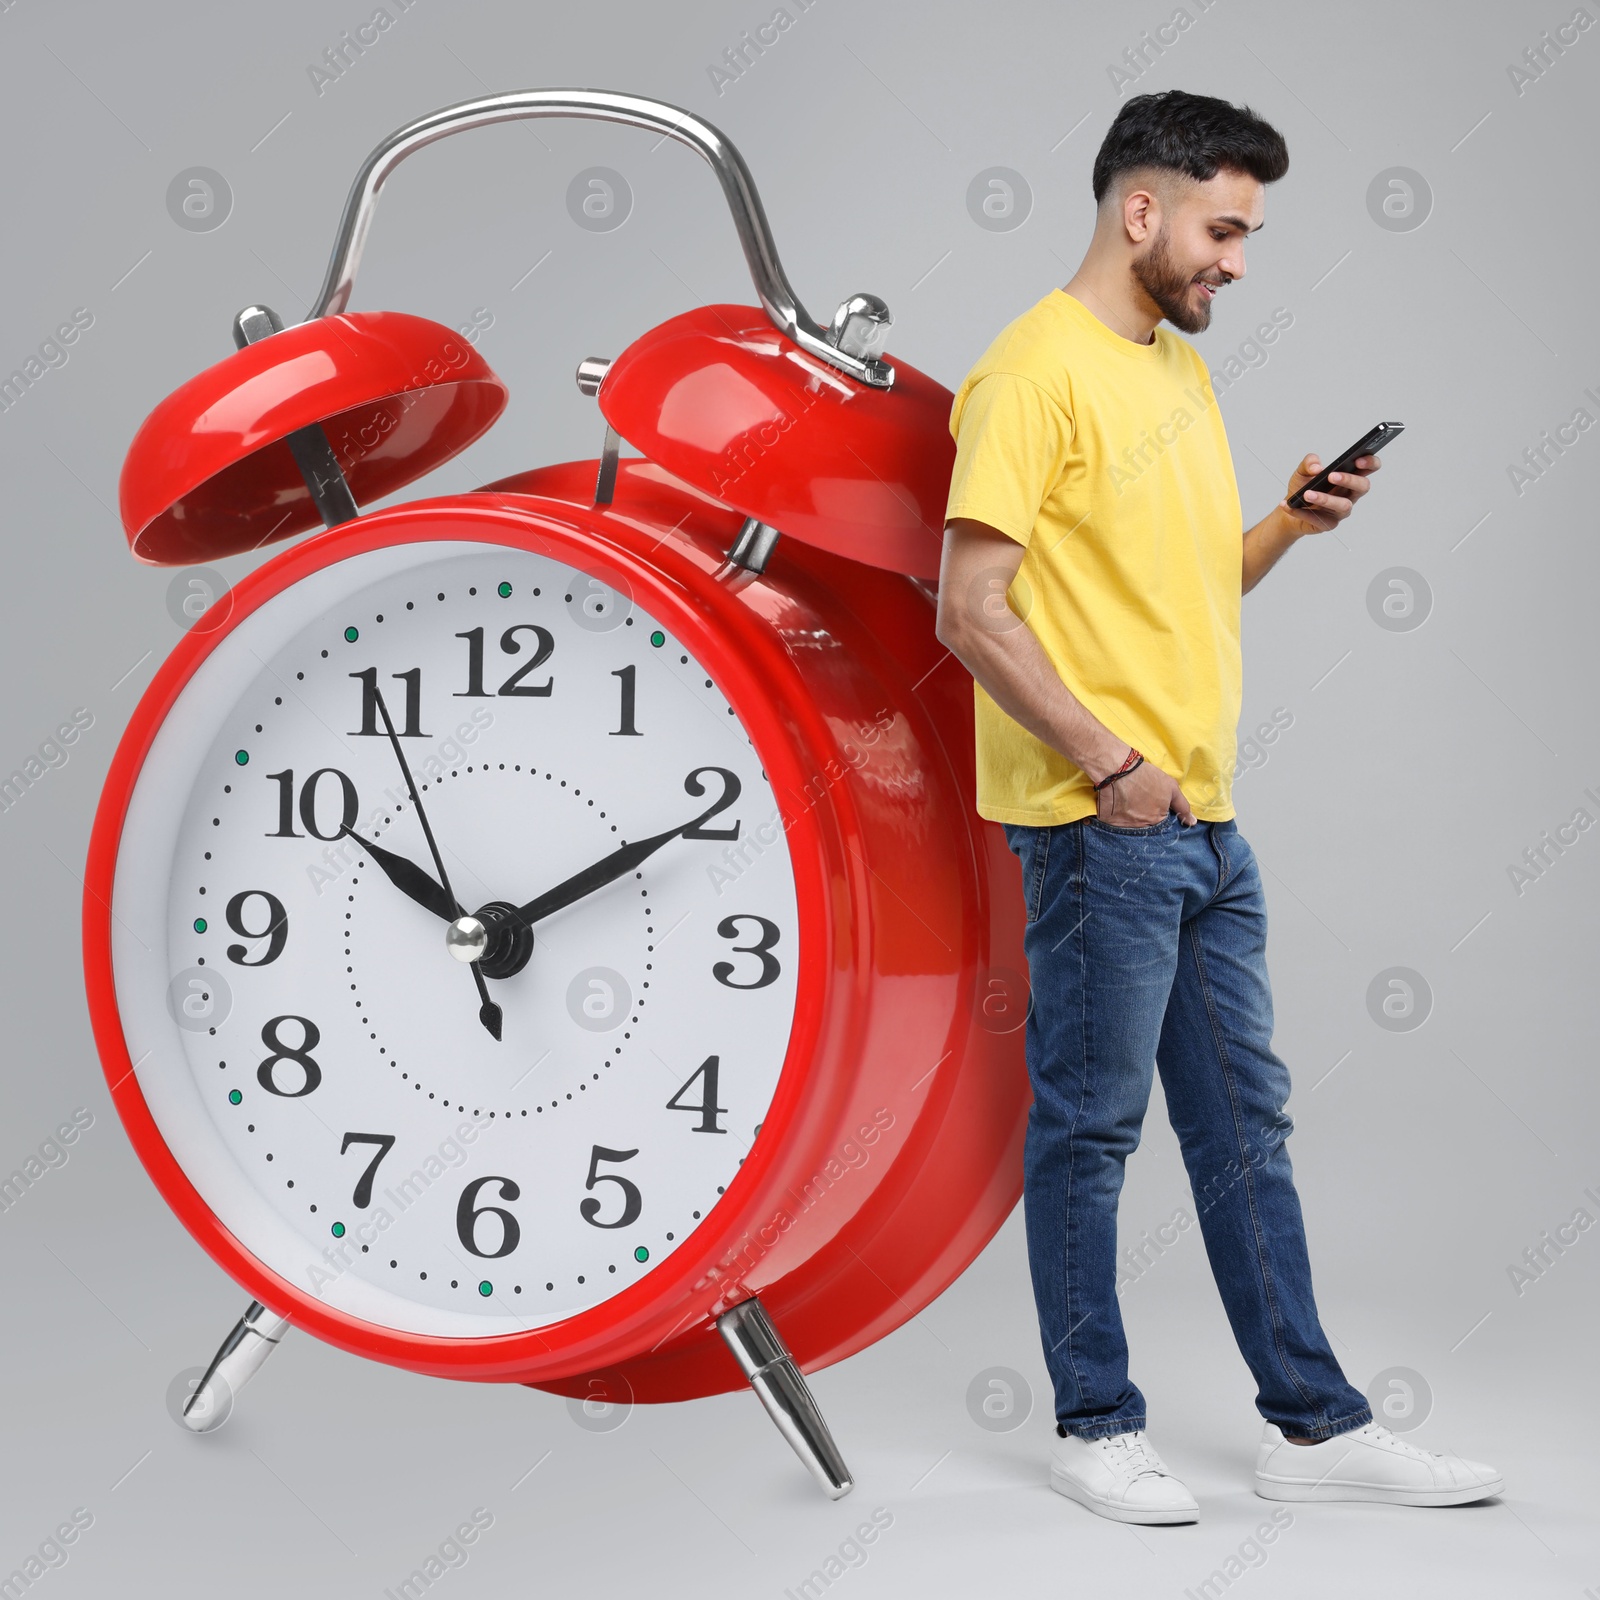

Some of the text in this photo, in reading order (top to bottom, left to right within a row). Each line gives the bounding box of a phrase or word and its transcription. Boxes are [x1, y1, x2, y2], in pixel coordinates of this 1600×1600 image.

[452, 624, 555, 698] 12
[347, 667, 433, 738] 11
[609, 665, 643, 736] 1
[265, 768, 358, 840] 10
[684, 767, 742, 841] 2
[226, 891, 288, 967] 9
[713, 915, 781, 990] 3
[257, 1016, 322, 1098] 8
[666, 1056, 728, 1134] 4
[341, 1133, 395, 1209] 7
[580, 1145, 641, 1229] 5
[457, 1177, 521, 1259] 6
